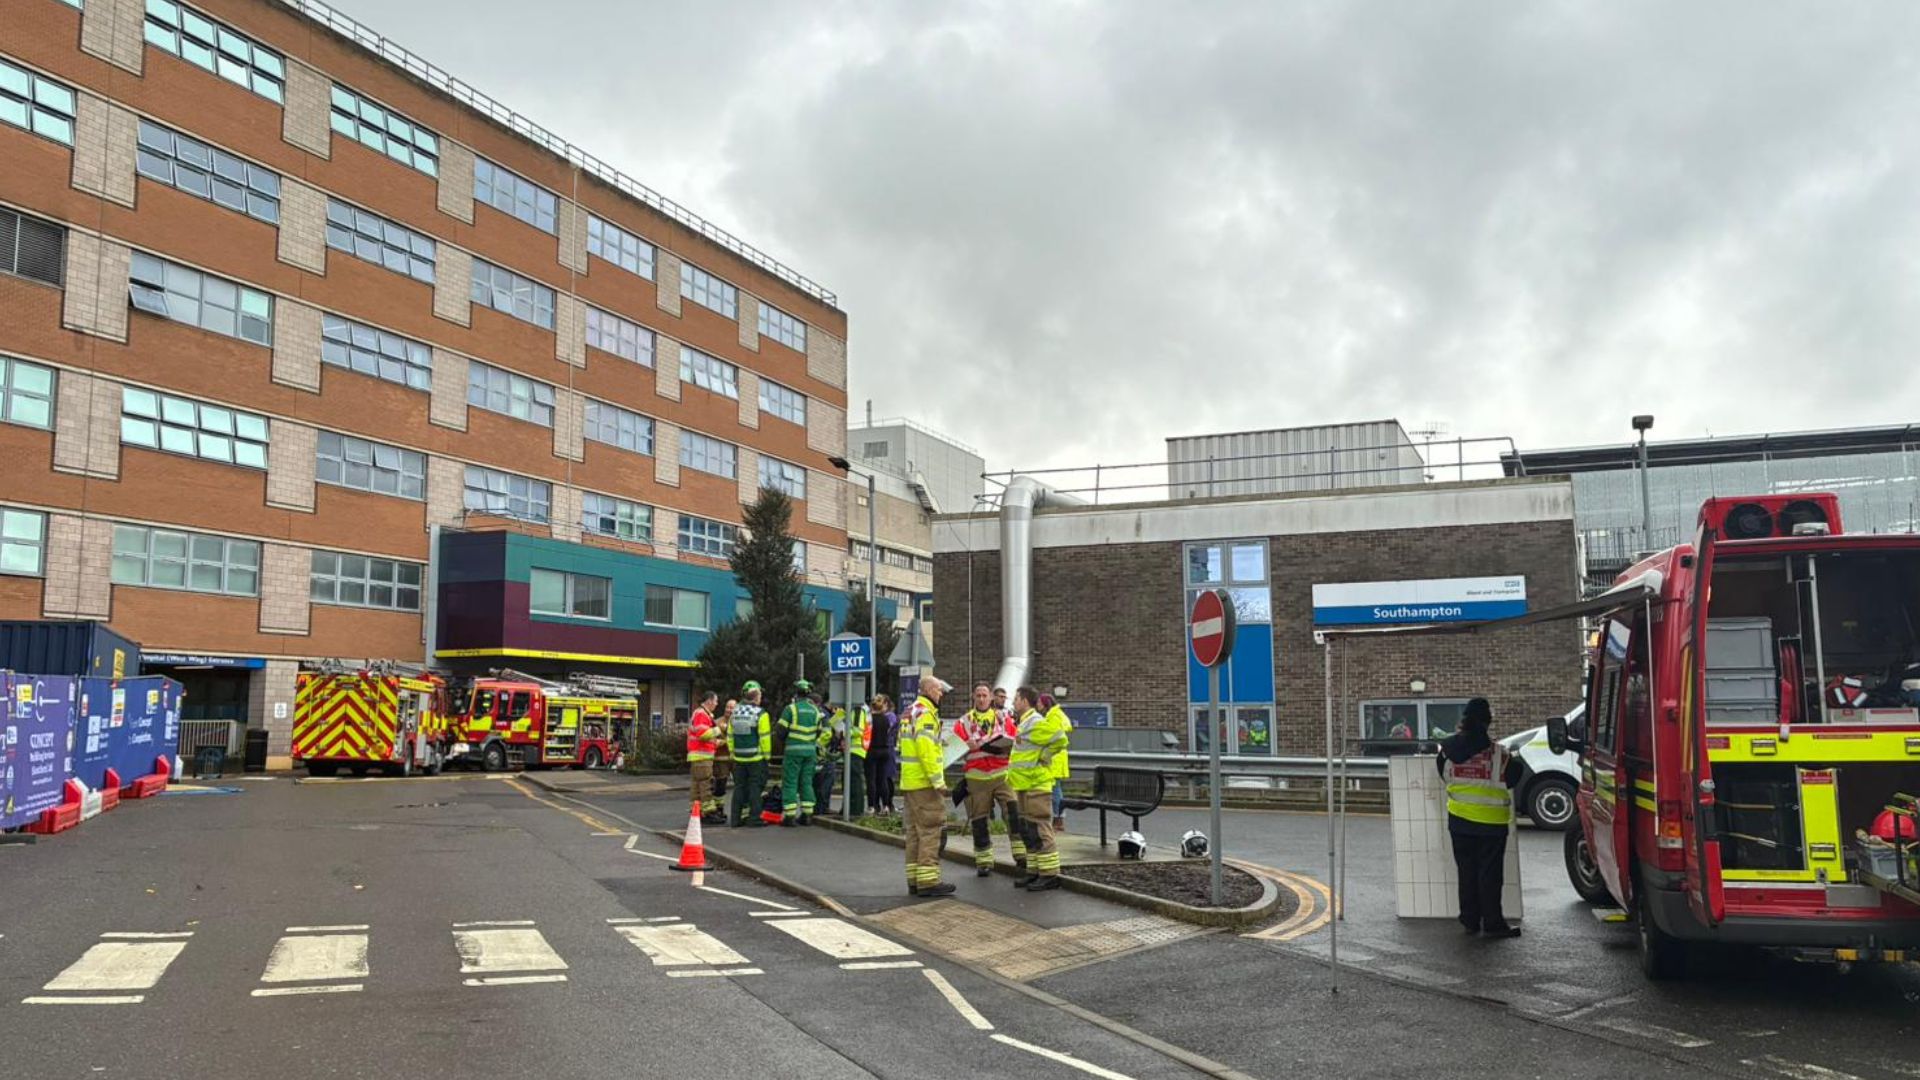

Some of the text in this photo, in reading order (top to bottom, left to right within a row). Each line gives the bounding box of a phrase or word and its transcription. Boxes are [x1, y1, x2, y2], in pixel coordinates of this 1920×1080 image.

[1373, 606, 1462, 619] Southampton
[841, 642, 860, 654] NO
[837, 656, 865, 668] EXIT
